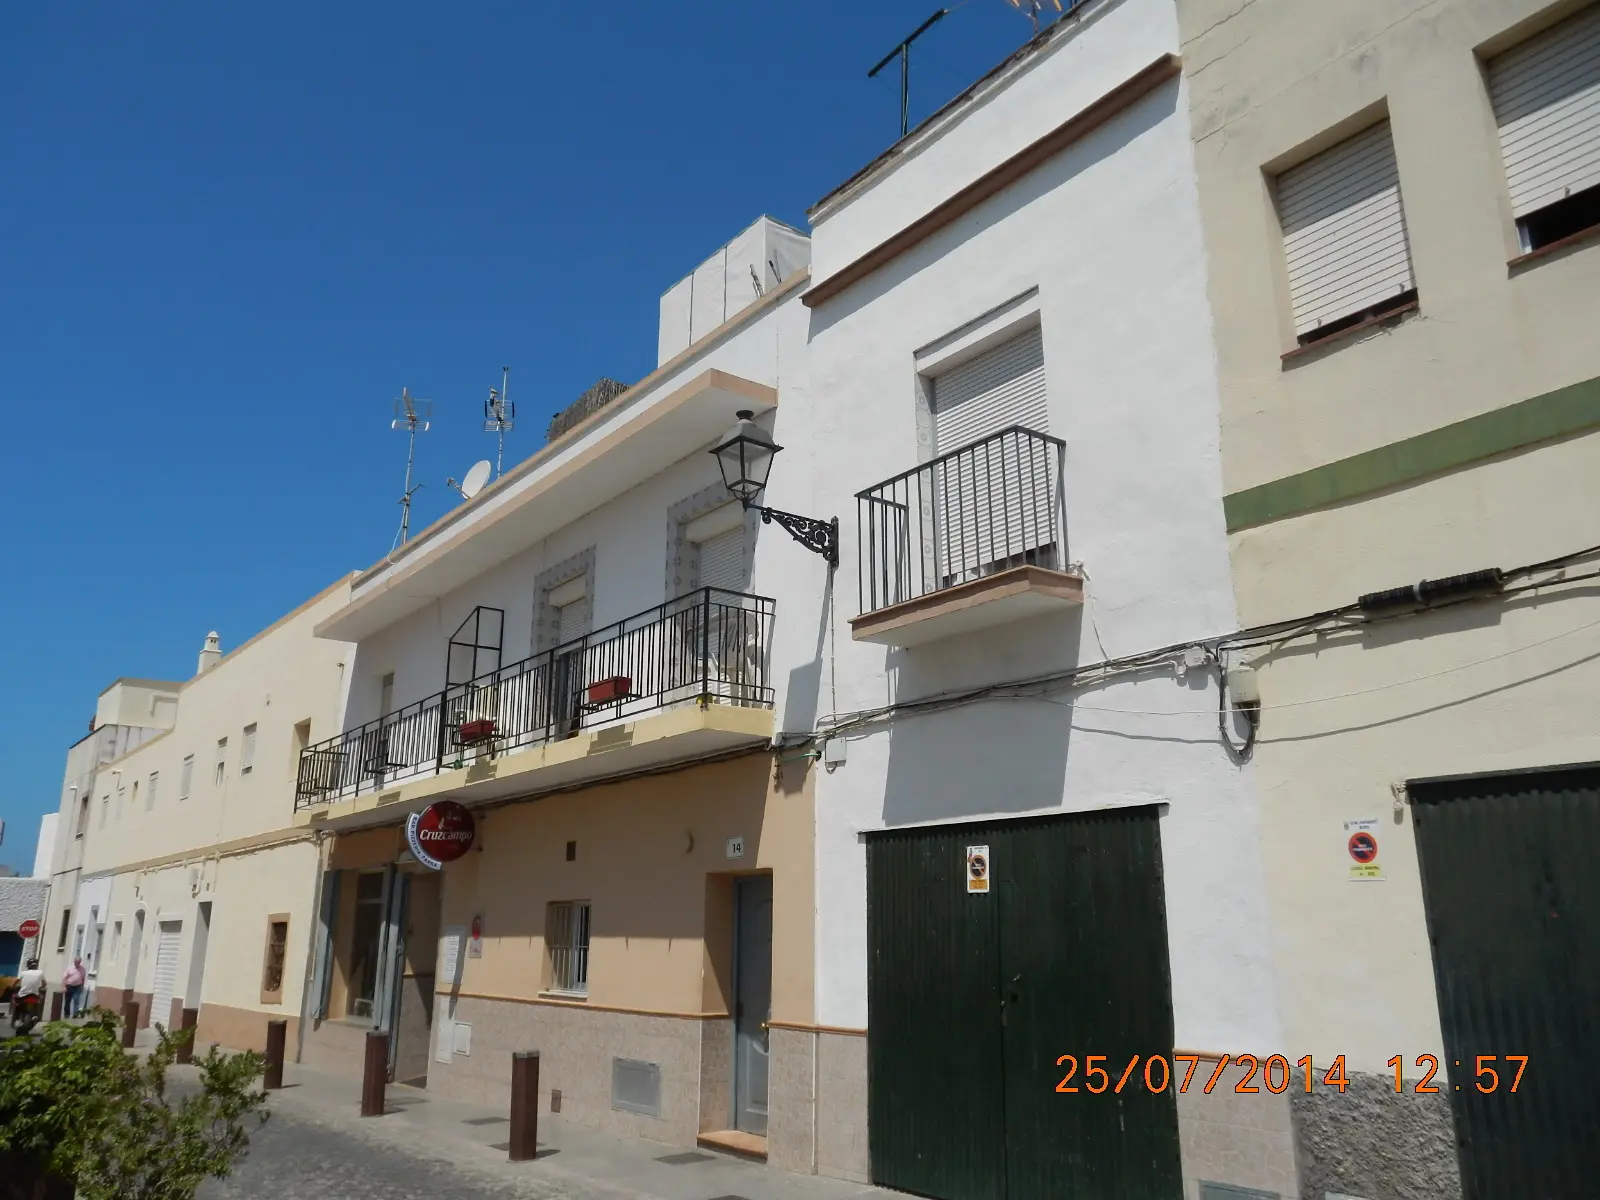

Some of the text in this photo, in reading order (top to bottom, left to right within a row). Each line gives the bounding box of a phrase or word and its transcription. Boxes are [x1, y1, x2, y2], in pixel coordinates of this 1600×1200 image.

[410, 816, 418, 829] BAR
[419, 829, 473, 842] Cruzcampo
[410, 830, 422, 856] PIZZERIA
[732, 843, 741, 853] 14
